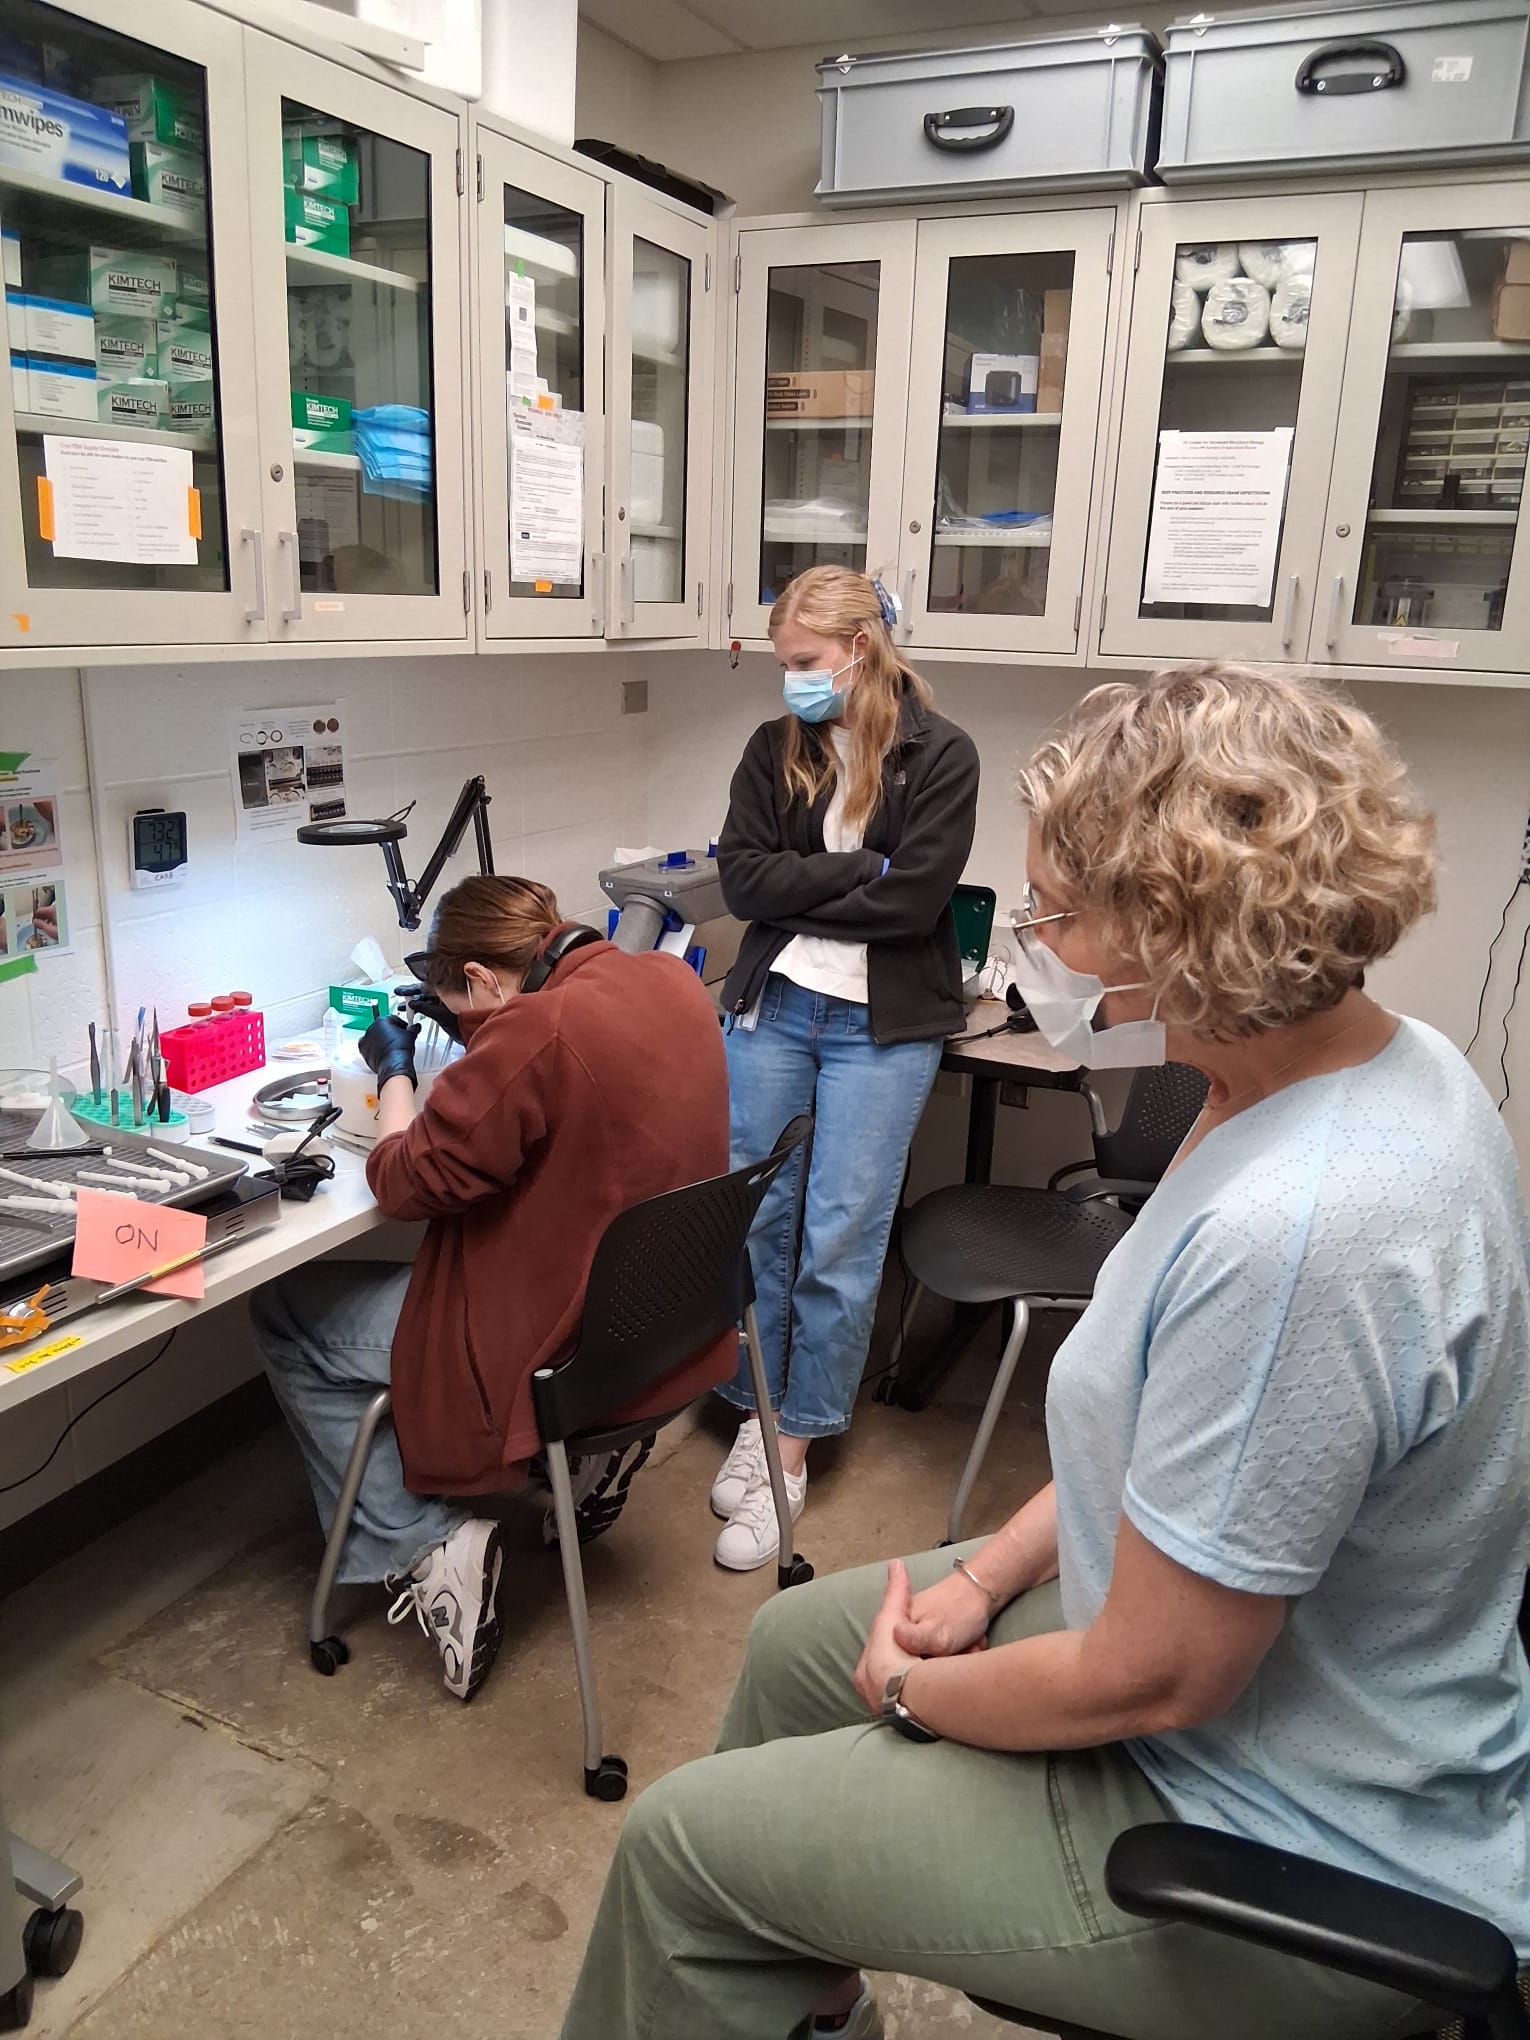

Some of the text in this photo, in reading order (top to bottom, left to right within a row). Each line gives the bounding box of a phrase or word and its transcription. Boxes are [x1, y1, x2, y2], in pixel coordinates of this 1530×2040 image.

[108, 273, 161, 291] KIMTECH
[100, 338, 144, 353] KIMTECH
[171, 347, 211, 364] KIMTECH
[111, 395, 157, 412] KIMTECH
[171, 403, 211, 414] KIMTECH
[306, 402, 338, 416] KIMTECH
[115, 1223, 158, 1252] ON
